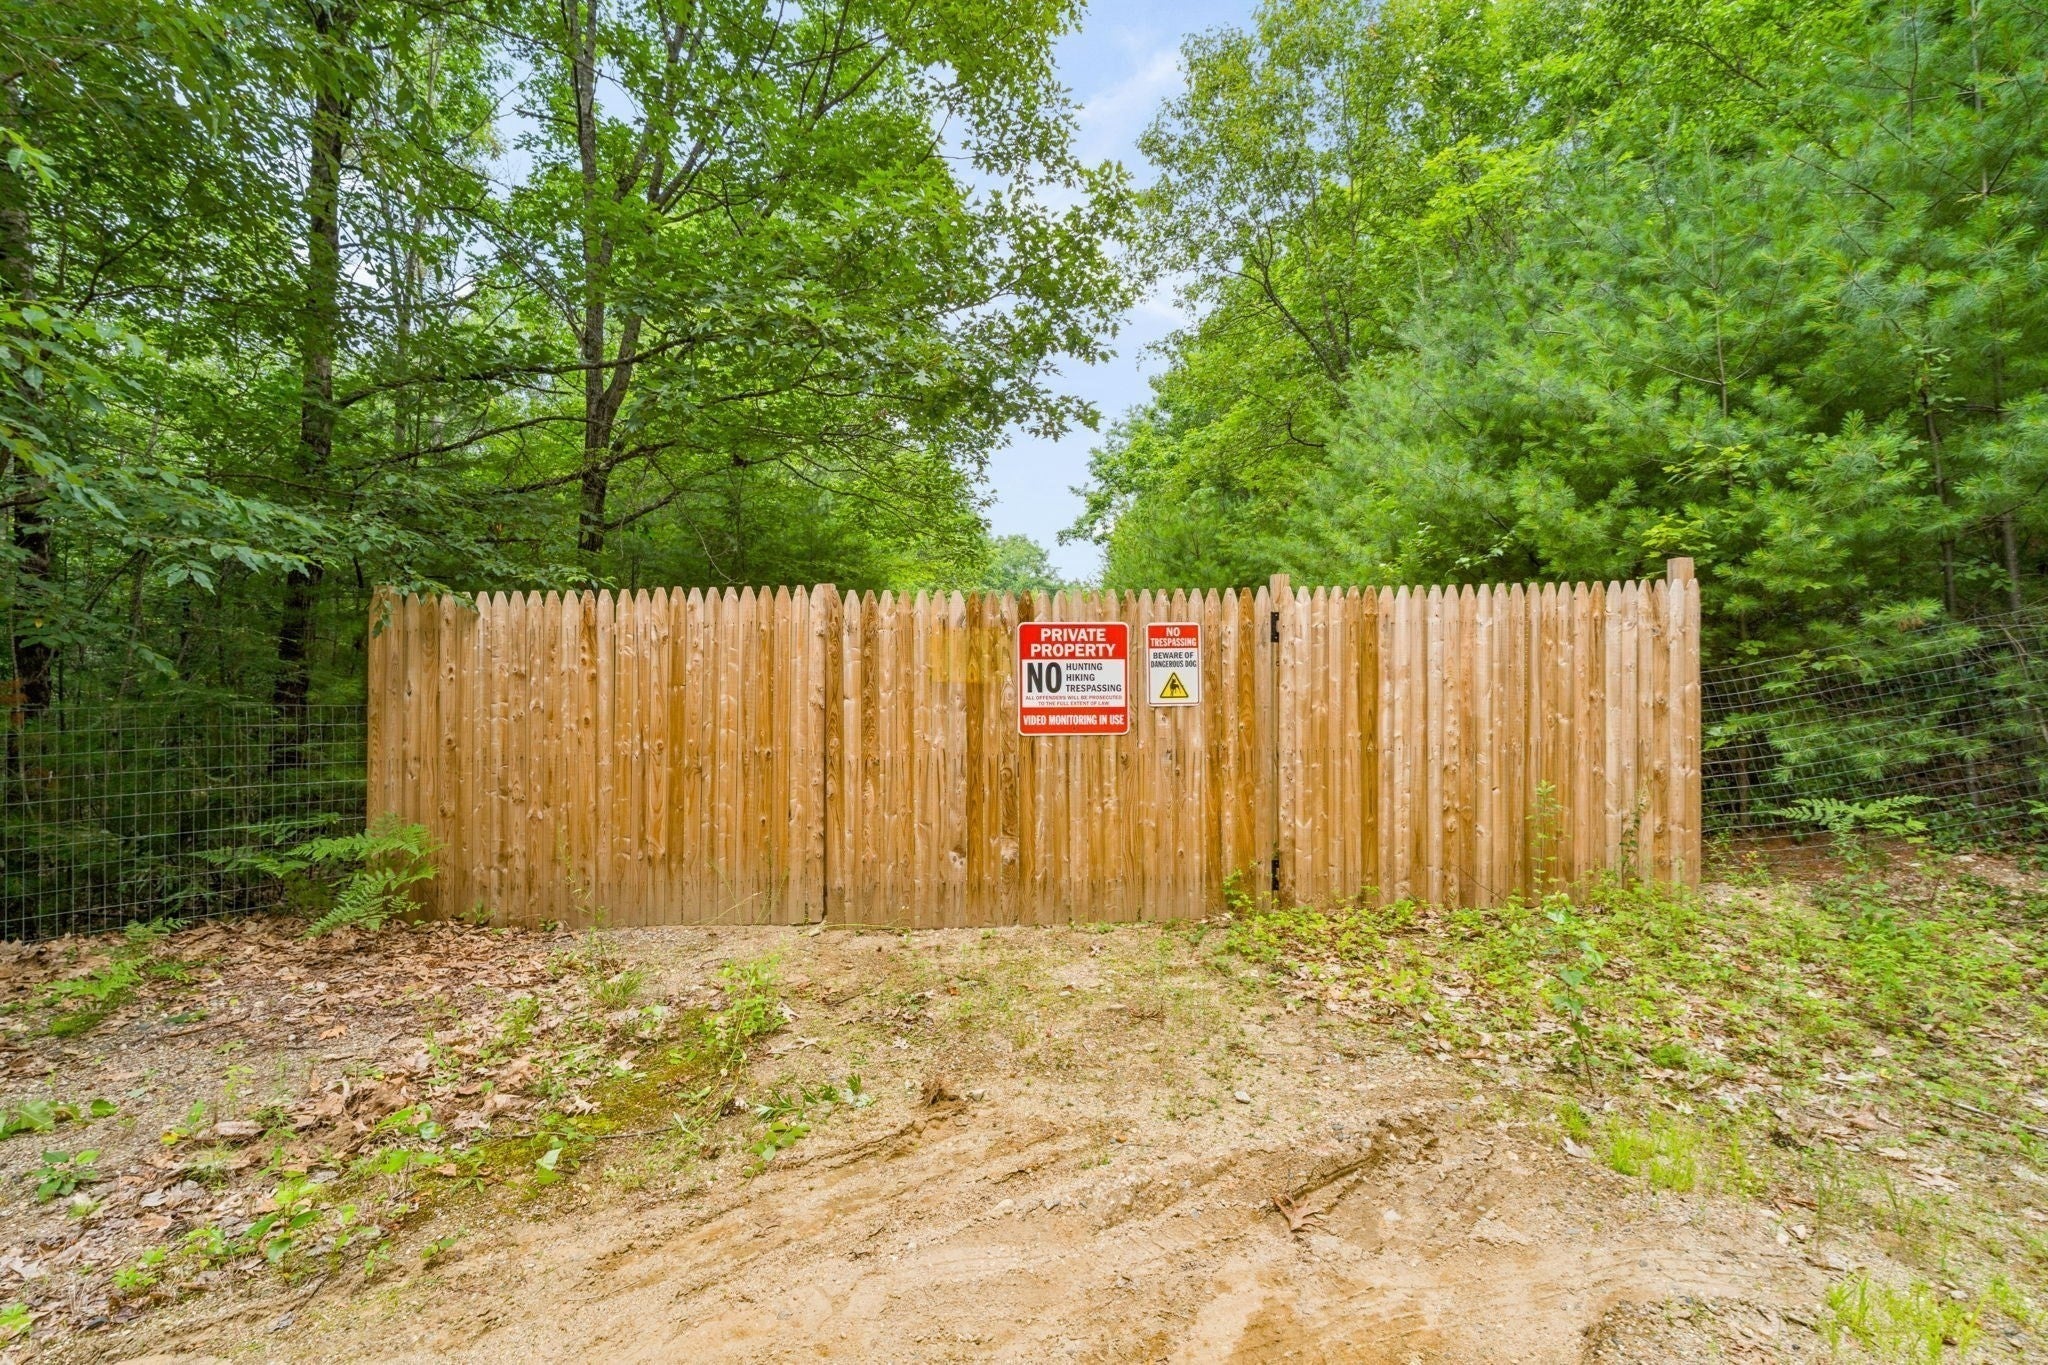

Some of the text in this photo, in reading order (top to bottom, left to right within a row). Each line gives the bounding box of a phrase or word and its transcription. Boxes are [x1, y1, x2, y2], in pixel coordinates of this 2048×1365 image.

[1040, 628, 1107, 642] PRIVATE
[1165, 627, 1181, 637] NO
[1150, 637, 1197, 647] TRESPASSING
[1030, 643, 1116, 657] PROPERTY
[1152, 651, 1194, 659] BEWARE OF
[1065, 662, 1103, 671] HUNTING
[1150, 660, 1197, 668] DANGEROUS DOG
[1027, 662, 1062, 693] NO
[1065, 673, 1095, 682] HIKING
[1065, 684, 1122, 692] TRESPASSING
[1023, 714, 1125, 726] VIDEO MONITORING IN USE
